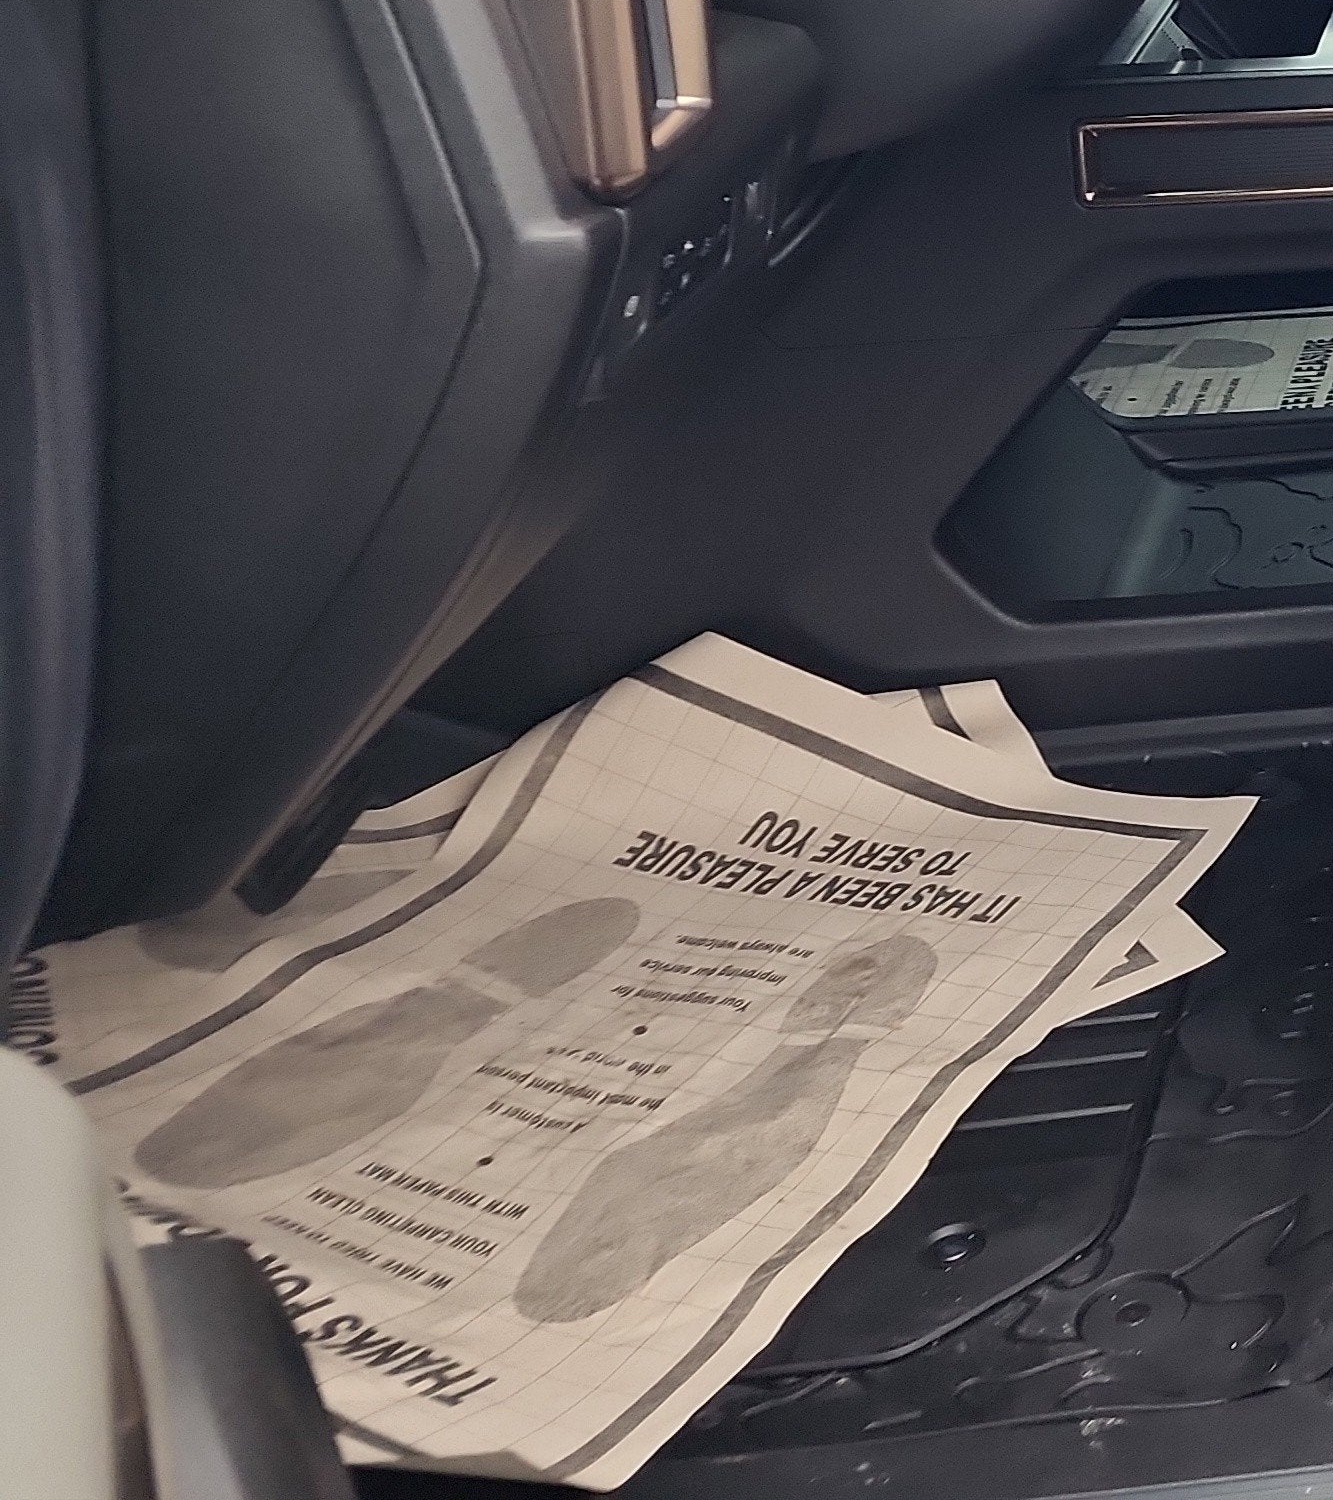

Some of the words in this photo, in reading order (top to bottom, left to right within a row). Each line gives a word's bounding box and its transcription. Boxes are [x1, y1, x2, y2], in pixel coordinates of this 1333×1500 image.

[737, 810, 819, 859] YOU
[610, 830, 795, 897] PLEASURE
[806, 832, 926, 874] SERVE
[921, 850, 974, 877] TO
[782, 871, 822, 899] A
[816, 874, 913, 911] BEEN
[898, 883, 982, 919] HAS
[970, 896, 1022, 924] IT
[722, 996, 752, 1014] Your
[641, 1097, 666, 1112] the
[355, 1161, 400, 1185] MAT
[390, 1172, 449, 1199] PAPER
[306, 1186, 365, 1216] CLEAN
[450, 1187, 487, 1208] THIS
[484, 1199, 530, 1221] WITH
[361, 1206, 452, 1245] CARPETING
[450, 1233, 499, 1258] YOUR
[381, 1259, 428, 1287] HAVE
[425, 1275, 453, 1292] WE
[300, 1315, 497, 1407] THANKS
